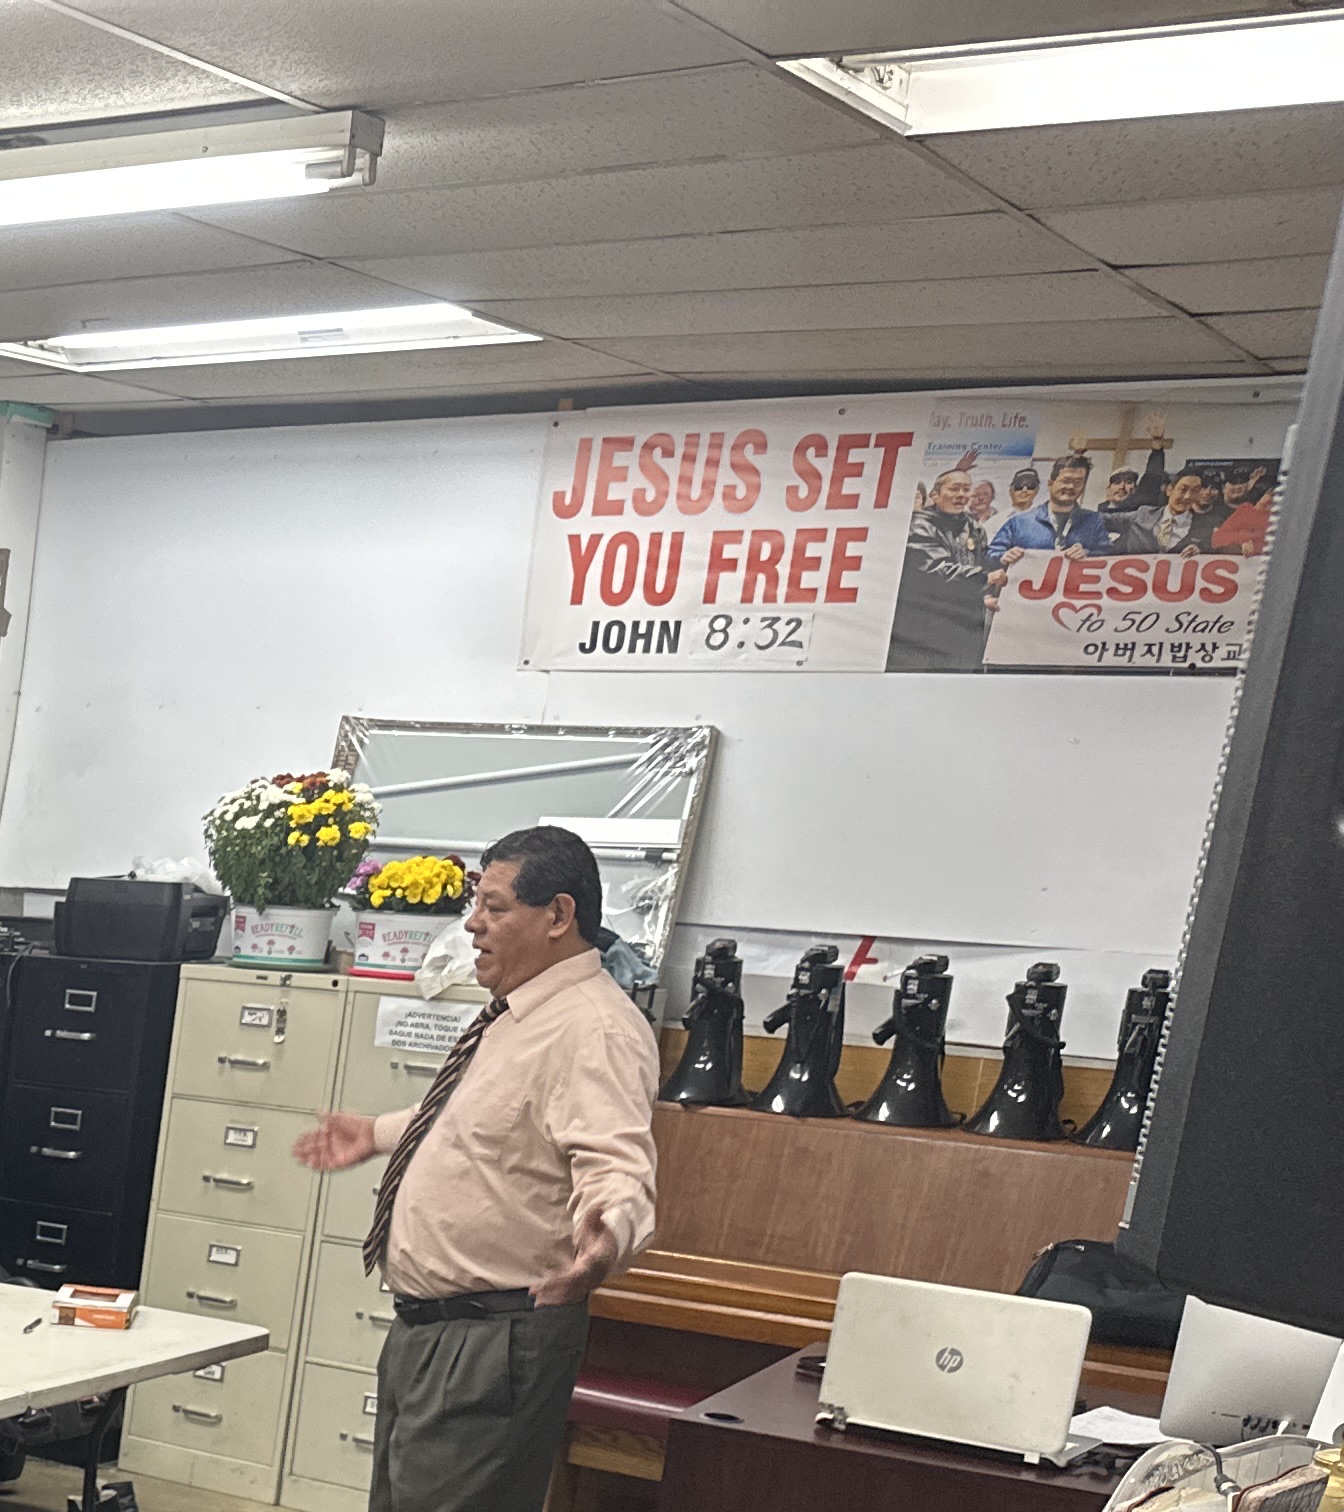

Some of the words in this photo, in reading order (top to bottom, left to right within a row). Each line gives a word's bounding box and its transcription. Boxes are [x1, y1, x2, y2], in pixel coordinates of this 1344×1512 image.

[552, 429, 768, 519] JESUS
[785, 432, 915, 513] SET
[567, 530, 685, 607] YOU
[702, 526, 869, 606] FREE
[1018, 555, 1240, 604] JESUS
[578, 619, 683, 656] JOHN
[704, 614, 805, 651] 8:32
[1075, 611, 1106, 634] to
[1113, 611, 1161, 634] 50
[1164, 610, 1235, 634] State
[938, 1346, 962, 1373] hp
